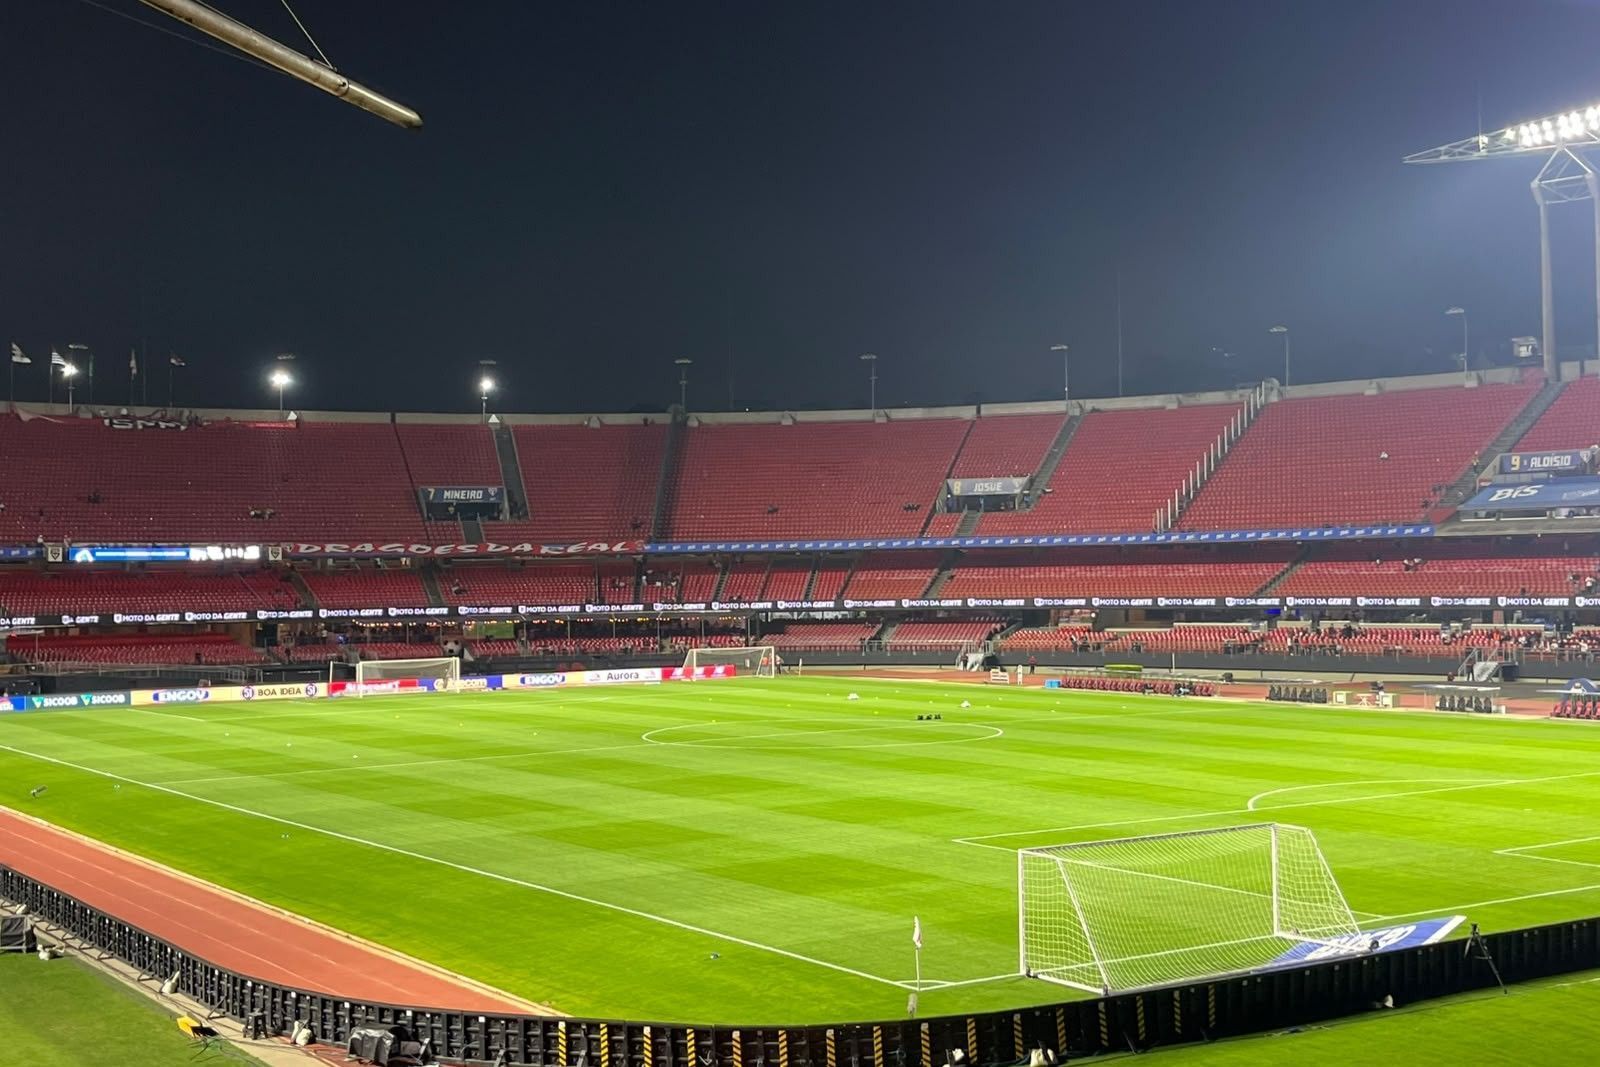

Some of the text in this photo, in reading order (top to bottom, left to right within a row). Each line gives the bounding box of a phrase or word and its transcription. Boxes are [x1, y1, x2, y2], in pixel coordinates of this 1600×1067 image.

[1511, 455, 1520, 471] 9
[427, 488, 483, 500] 7 MINEIRO
[487, 542, 533, 552] DA
[525, 675, 563, 684] ENGOV
[606, 671, 639, 681] Aurora
[157, 690, 206, 701] ENGOV
[280, 687, 302, 695] IDEIA
[43, 696, 78, 707] SICOOB
[91, 694, 125, 704] SICOOB
